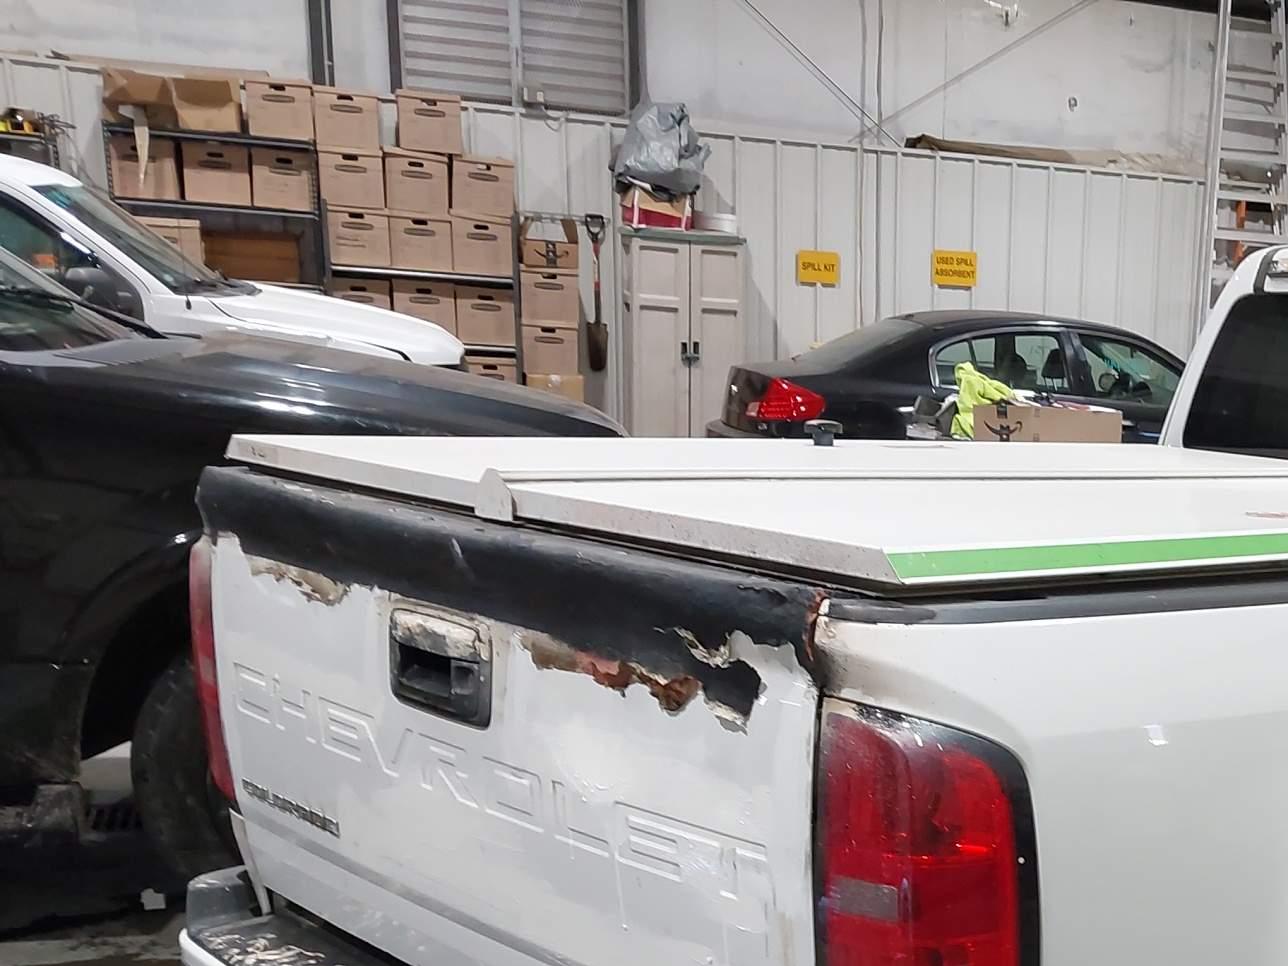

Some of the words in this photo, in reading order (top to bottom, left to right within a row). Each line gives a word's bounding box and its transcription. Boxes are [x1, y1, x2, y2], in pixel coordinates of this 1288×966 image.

[801, 261, 822, 272] SPILL
[823, 263, 836, 273] KIT
[935, 256, 955, 266] USED
[956, 257, 975, 267] SPILL
[934, 268, 976, 279] ABSORBENT
[234, 661, 769, 901] CHEVROLET
